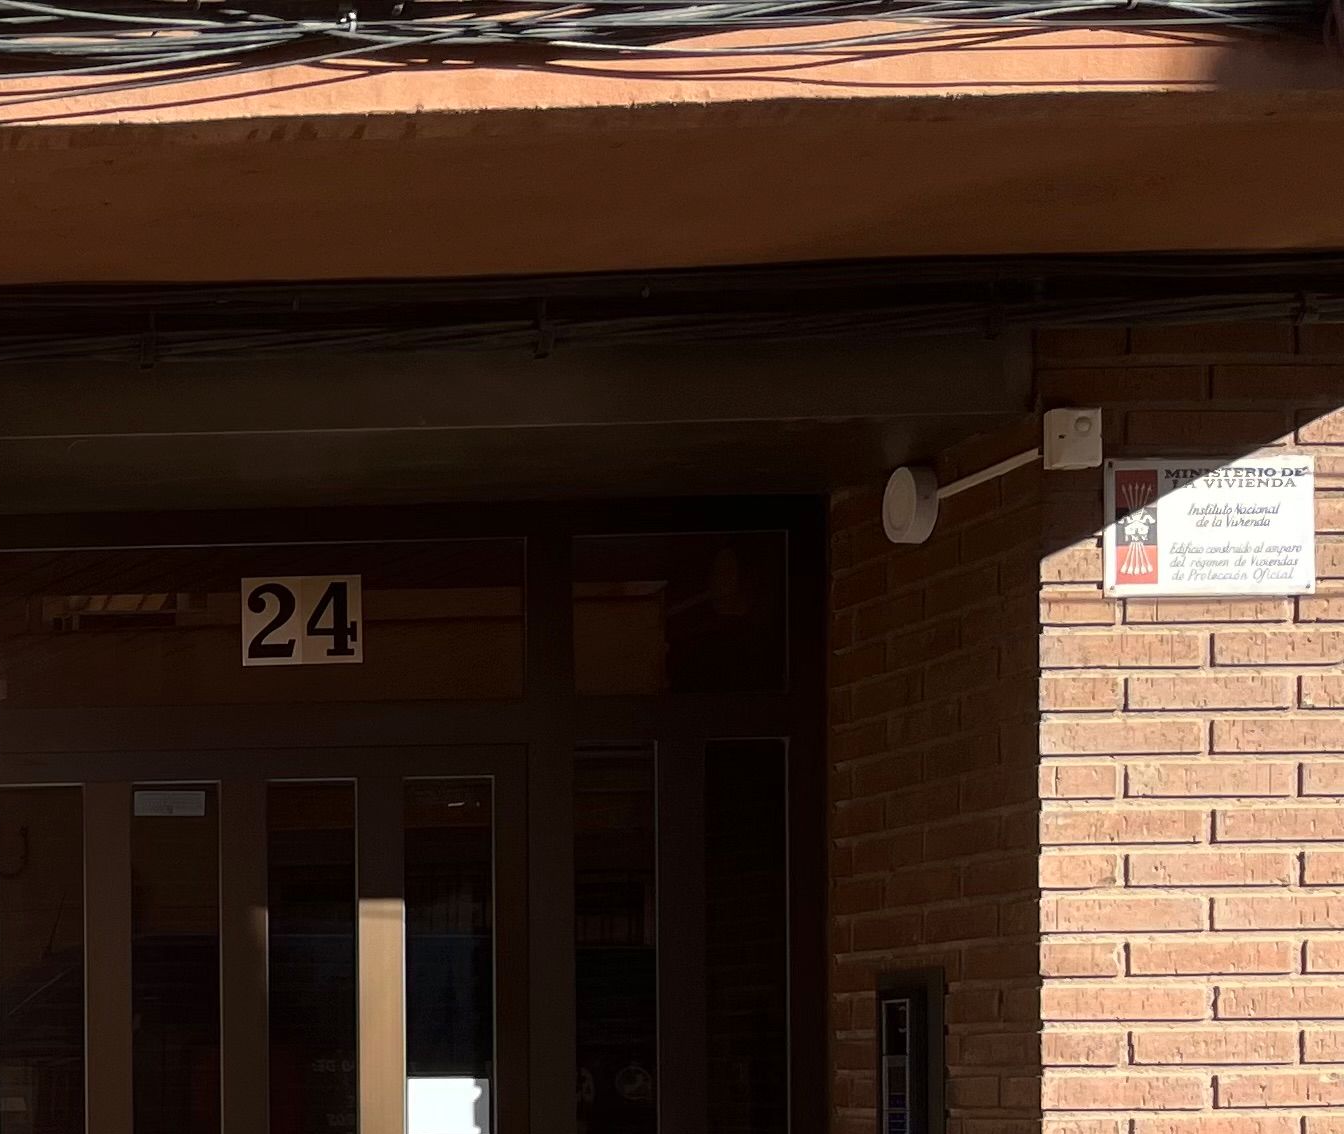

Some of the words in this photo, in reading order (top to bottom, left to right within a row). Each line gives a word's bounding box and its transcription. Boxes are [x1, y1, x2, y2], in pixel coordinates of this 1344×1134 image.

[1164, 467, 1277, 479] MINISTERIO
[1280, 467, 1306, 478] DE
[1172, 478, 1197, 489] LA
[1203, 478, 1297, 489] VIVIENDA
[1187, 503, 1233, 516] Instituto
[1234, 502, 1281, 515] Nacional
[1196, 516, 1209, 528] de
[1210, 517, 1223, 528] la
[1169, 556, 1185, 568] del
[1233, 555, 1248, 568] de
[1171, 569, 1186, 581] de
[1252, 567, 1295, 583] Oficial
[248, 582, 358, 659] 24
